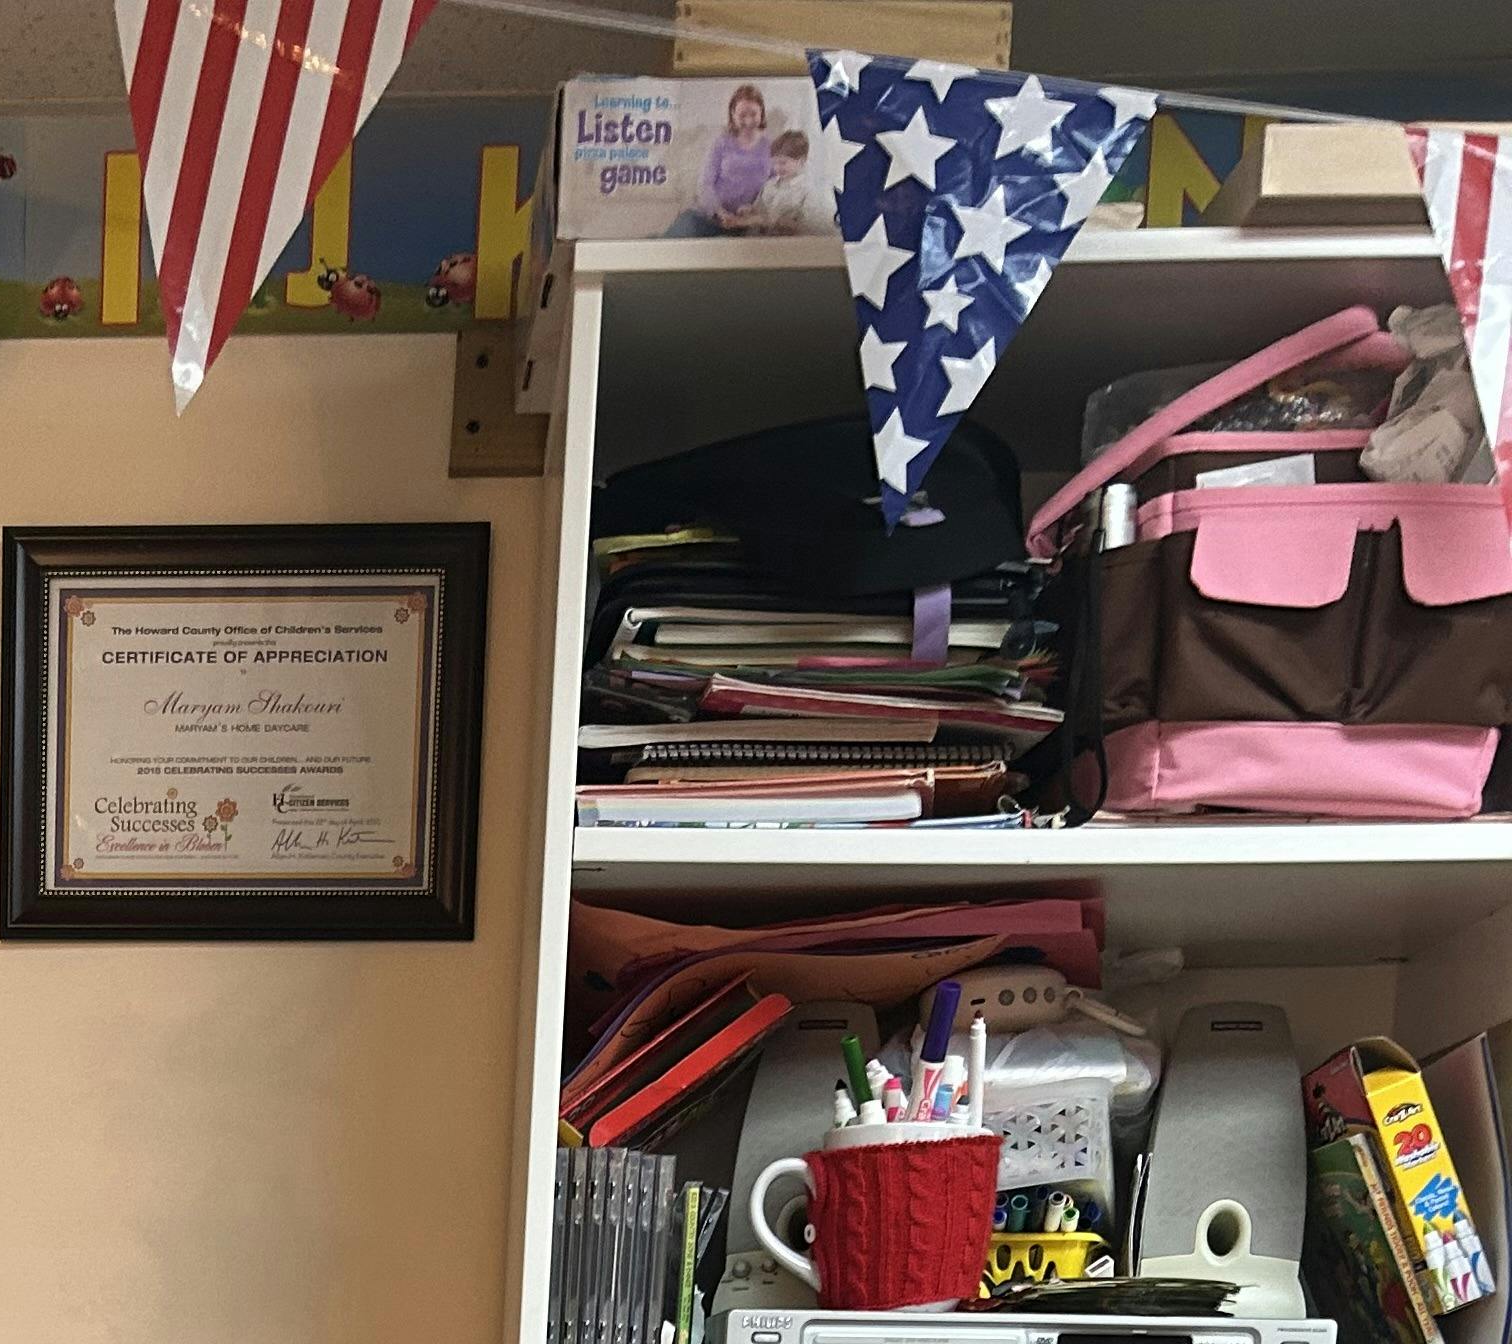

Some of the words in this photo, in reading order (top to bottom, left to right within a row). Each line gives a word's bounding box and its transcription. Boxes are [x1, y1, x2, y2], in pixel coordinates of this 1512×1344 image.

[594, 95, 651, 112] Learning
[578, 110, 672, 144] Listen
[600, 164, 667, 194] game
[101, 152, 142, 325] I
[112, 626, 133, 635] The
[135, 626, 180, 635] Howard
[183, 626, 221, 637] County
[224, 625, 257, 635] Office
[260, 625, 272, 634] of
[275, 625, 331, 634] Children's
[334, 624, 383, 634] Services
[102, 650, 217, 664] CERTIFICATE
[224, 650, 248, 664] OF
[254, 649, 388, 664] APPRECIATION
[144, 690, 241, 722] Maryam
[248, 688, 345, 714] Shakouri
[231, 724, 260, 733] HOME
[264, 723, 310, 733] DAYCARE
[164, 766, 234, 775] CELEBRATING
[236, 766, 297, 775] SUCCESSES
[299, 765, 343, 775] AWARDS
[94, 796, 198, 819] Celebrating
[111, 816, 195, 833] Successes
[1393, 1124, 1433, 1157] 20
